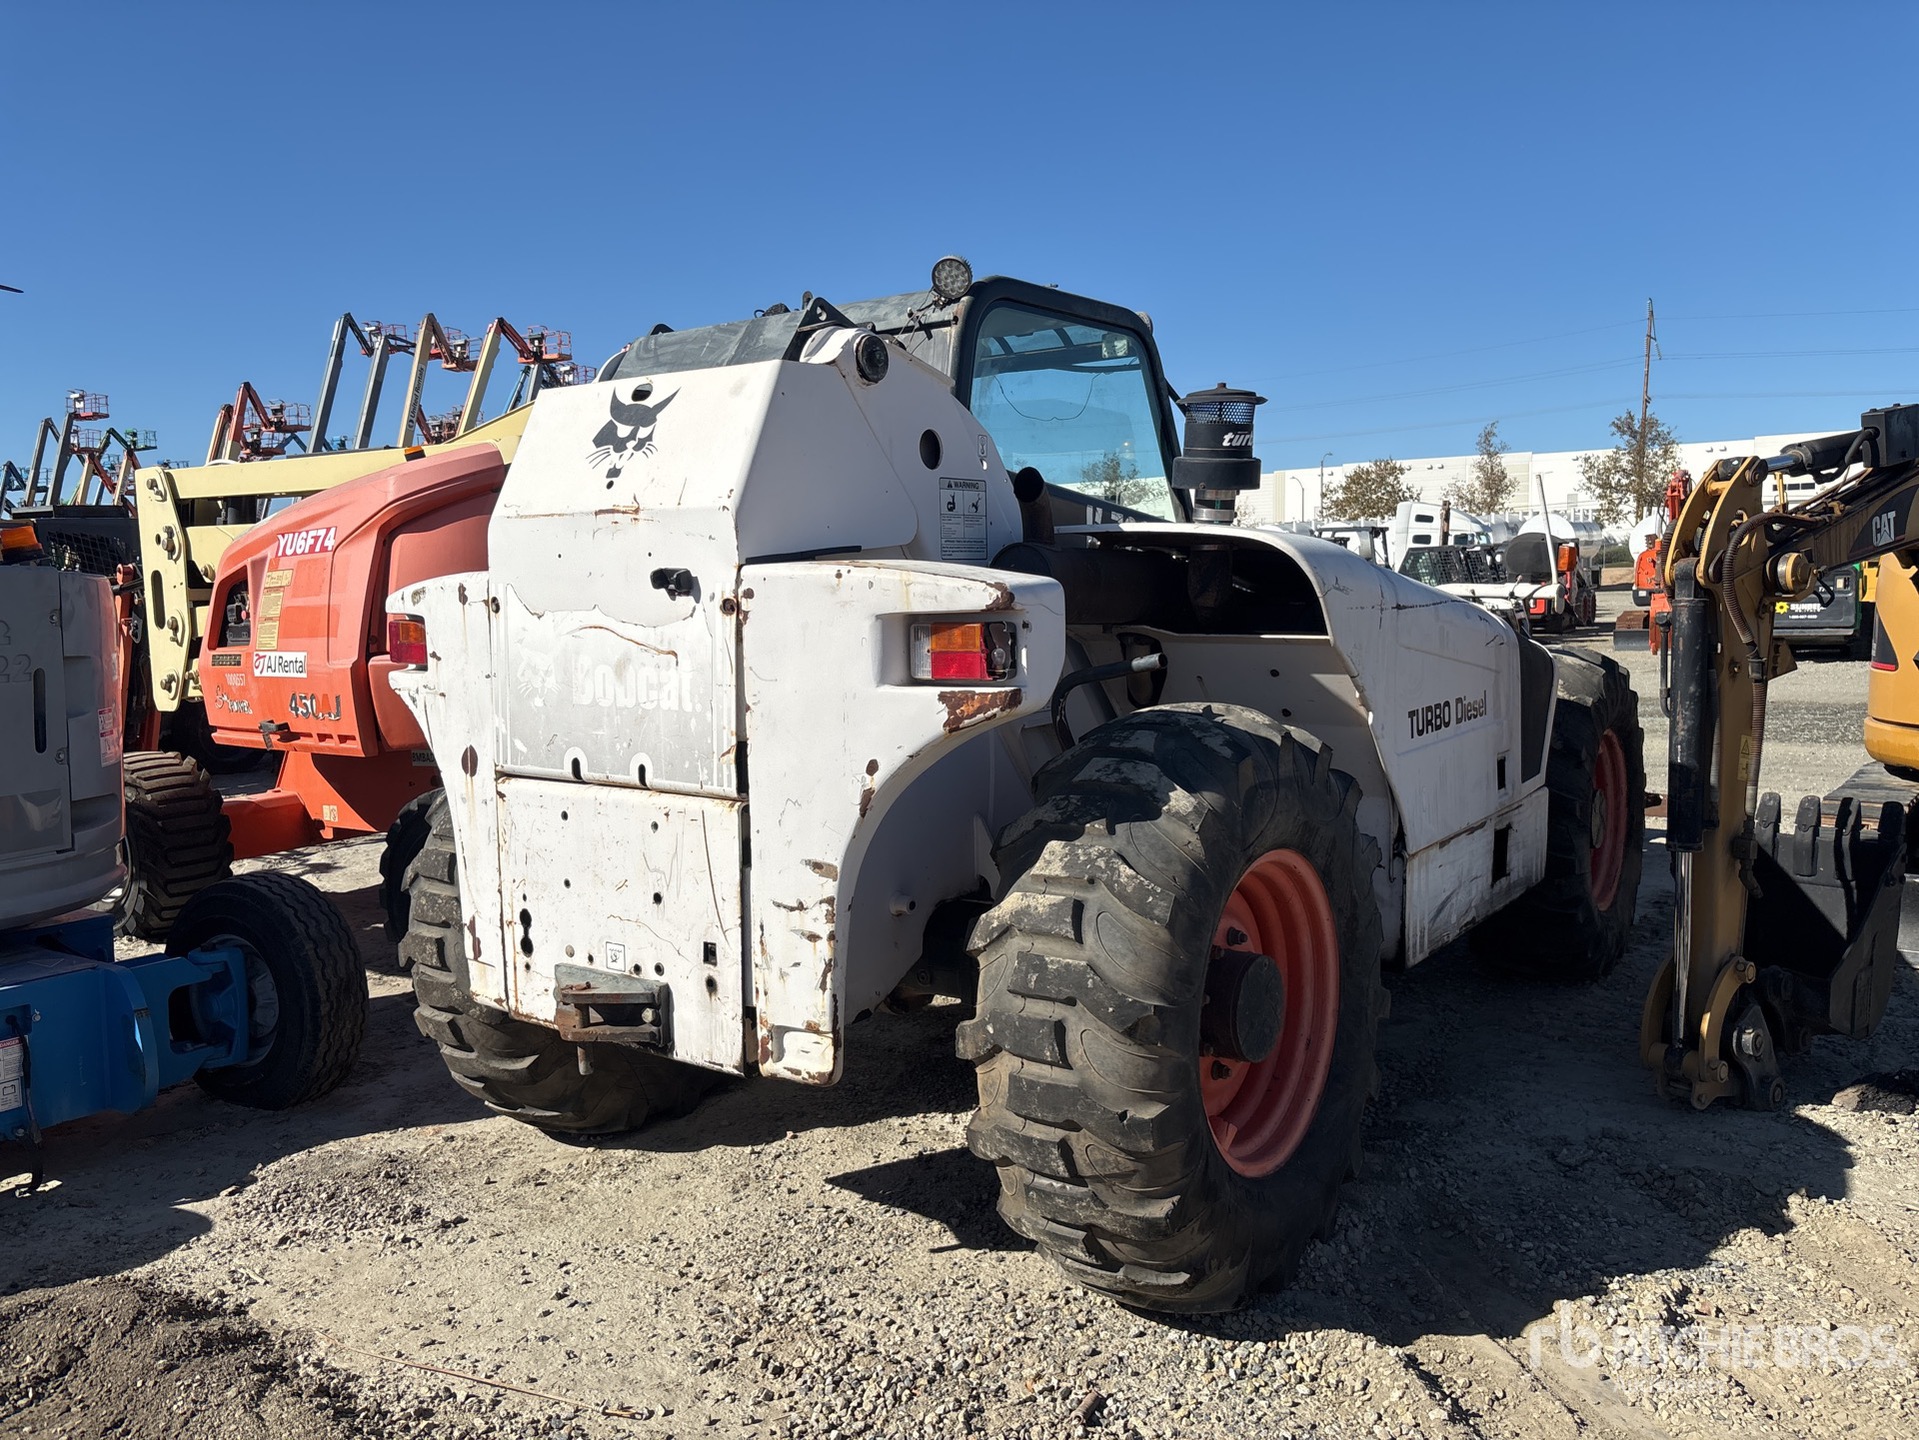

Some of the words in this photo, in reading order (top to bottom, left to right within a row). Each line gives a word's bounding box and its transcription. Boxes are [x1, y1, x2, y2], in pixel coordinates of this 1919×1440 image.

[410, 394, 419, 418] United
[415, 367, 424, 393] Rentals
[954, 481, 980, 490] WARNING
[277, 527, 337, 556] YU6F74
[1872, 510, 1896, 547] CAT
[266, 655, 277, 674] AJ
[279, 655, 306, 675] Rental
[1407, 700, 1451, 739] TURBO
[1455, 689, 1487, 725] Diesel
